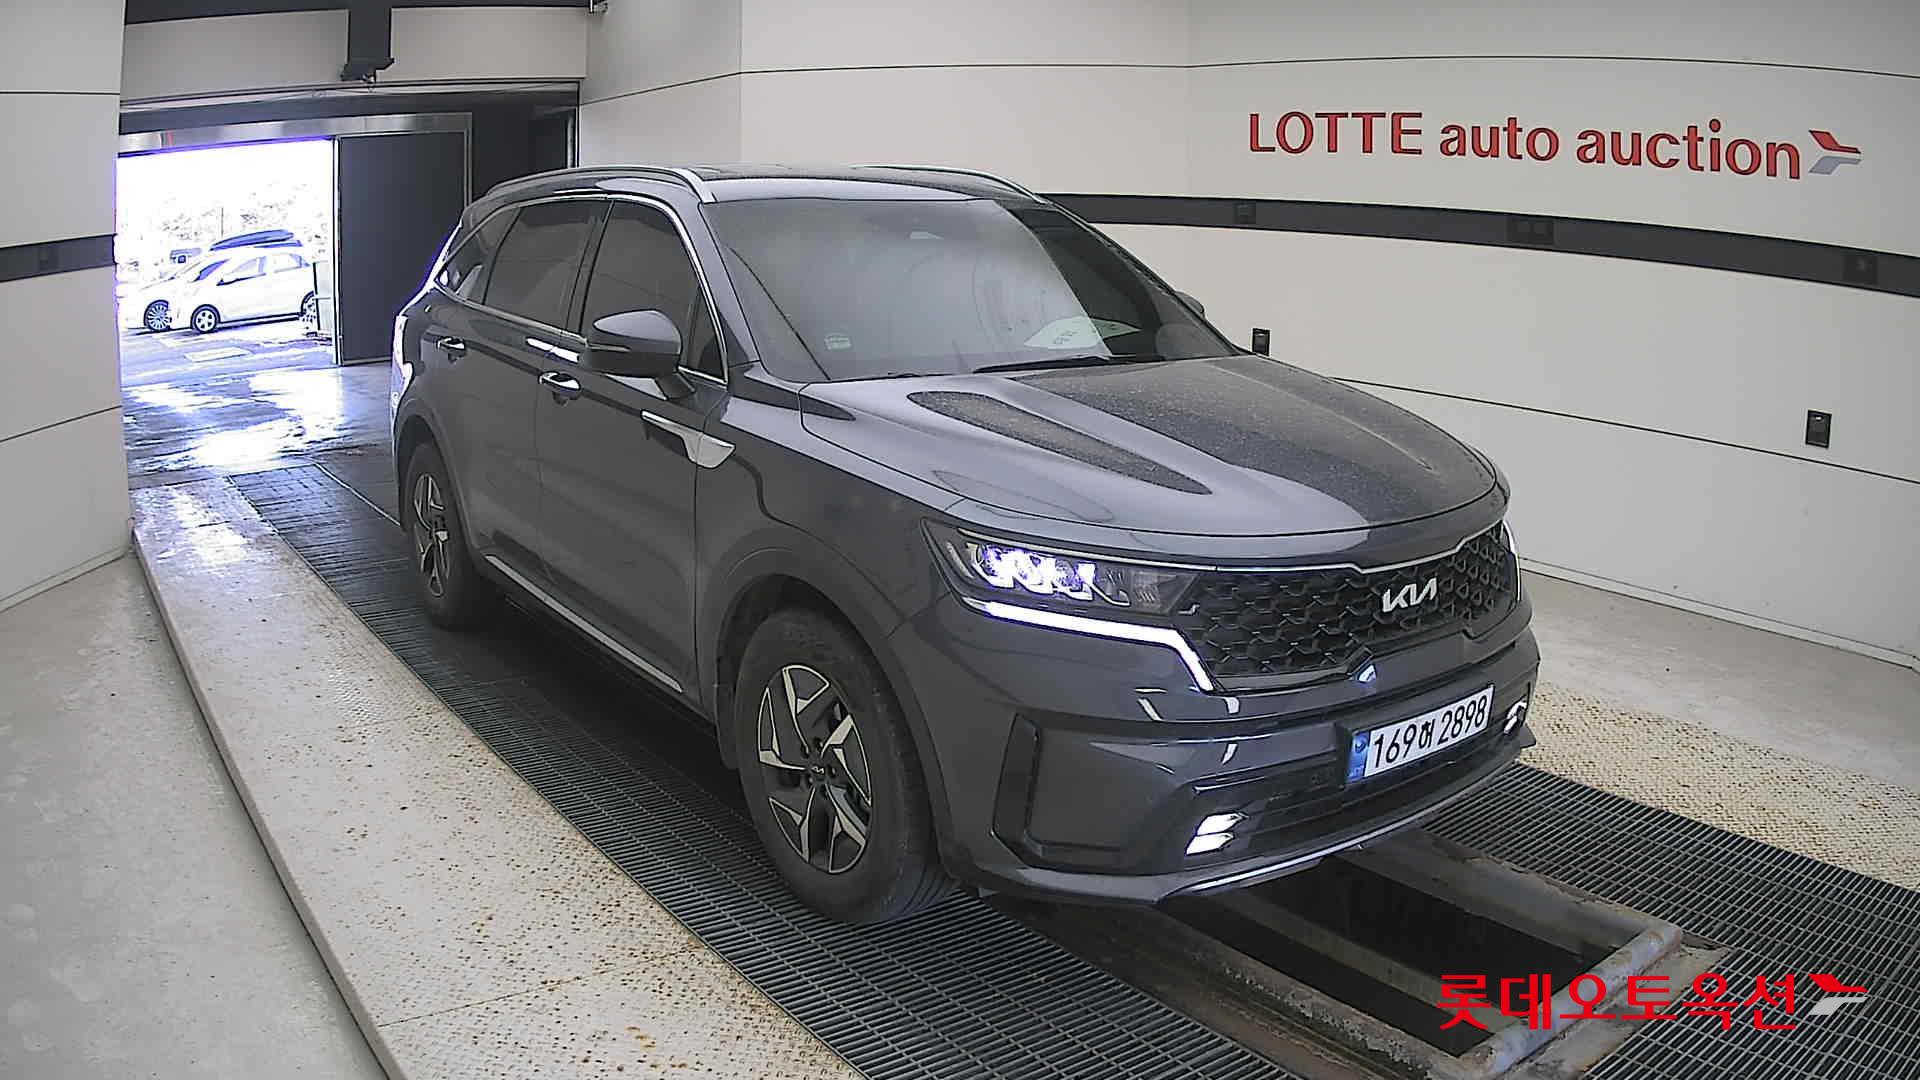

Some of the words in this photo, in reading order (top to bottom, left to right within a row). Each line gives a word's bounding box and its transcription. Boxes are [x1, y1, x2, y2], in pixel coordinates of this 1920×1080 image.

[1248, 111, 1423, 155] LOTTE
[1438, 117, 1560, 161] auto
[1576, 118, 1801, 180] auction
[1437, 695, 1488, 745] 2898
